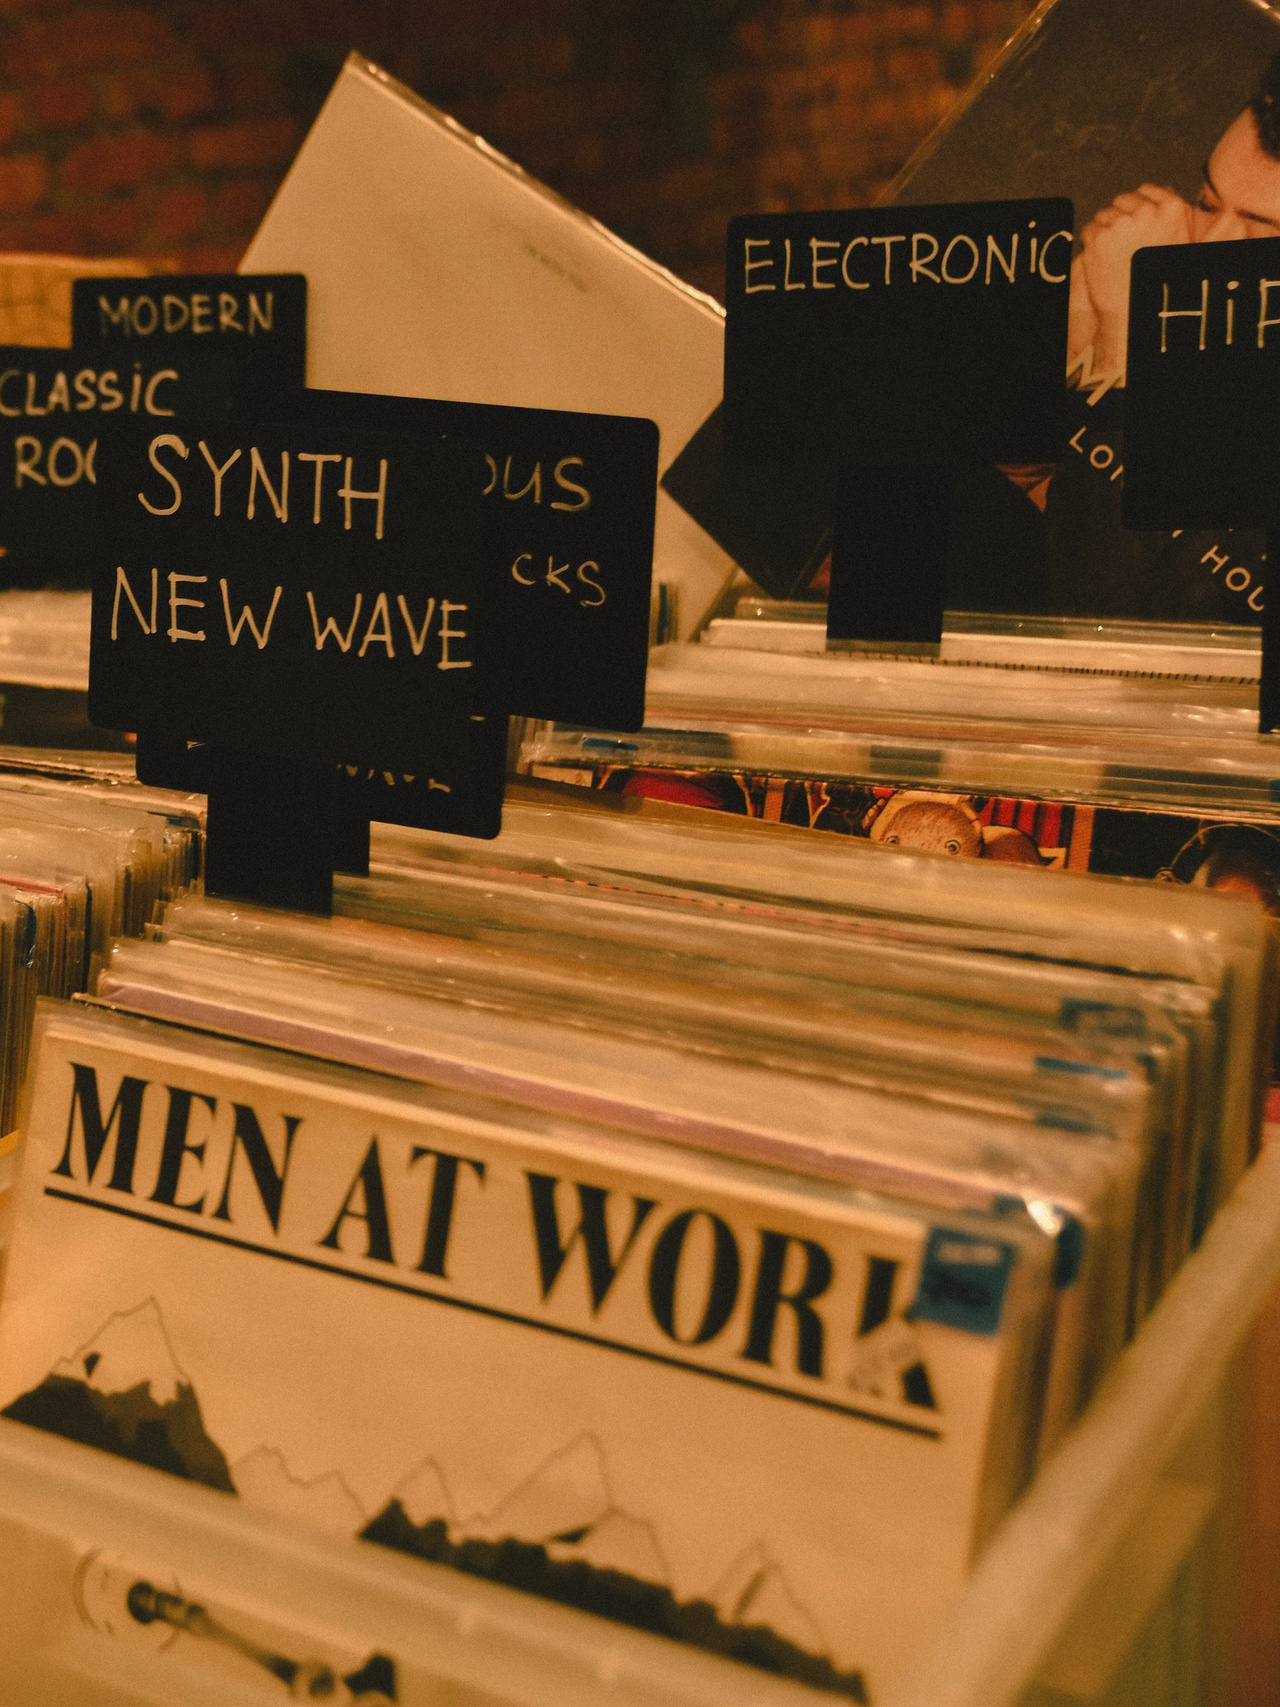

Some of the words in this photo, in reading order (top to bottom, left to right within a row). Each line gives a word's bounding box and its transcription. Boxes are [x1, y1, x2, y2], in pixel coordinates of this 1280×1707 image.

[97, 290, 275, 337] MODERN
[138, 434, 388, 540] SYNTH
[110, 566, 283, 650] NEW
[306, 591, 474, 670] WAVE
[511, 553, 606, 607] CKS
[50, 1060, 302, 1236] MEN
[316, 1134, 487, 1281] AT
